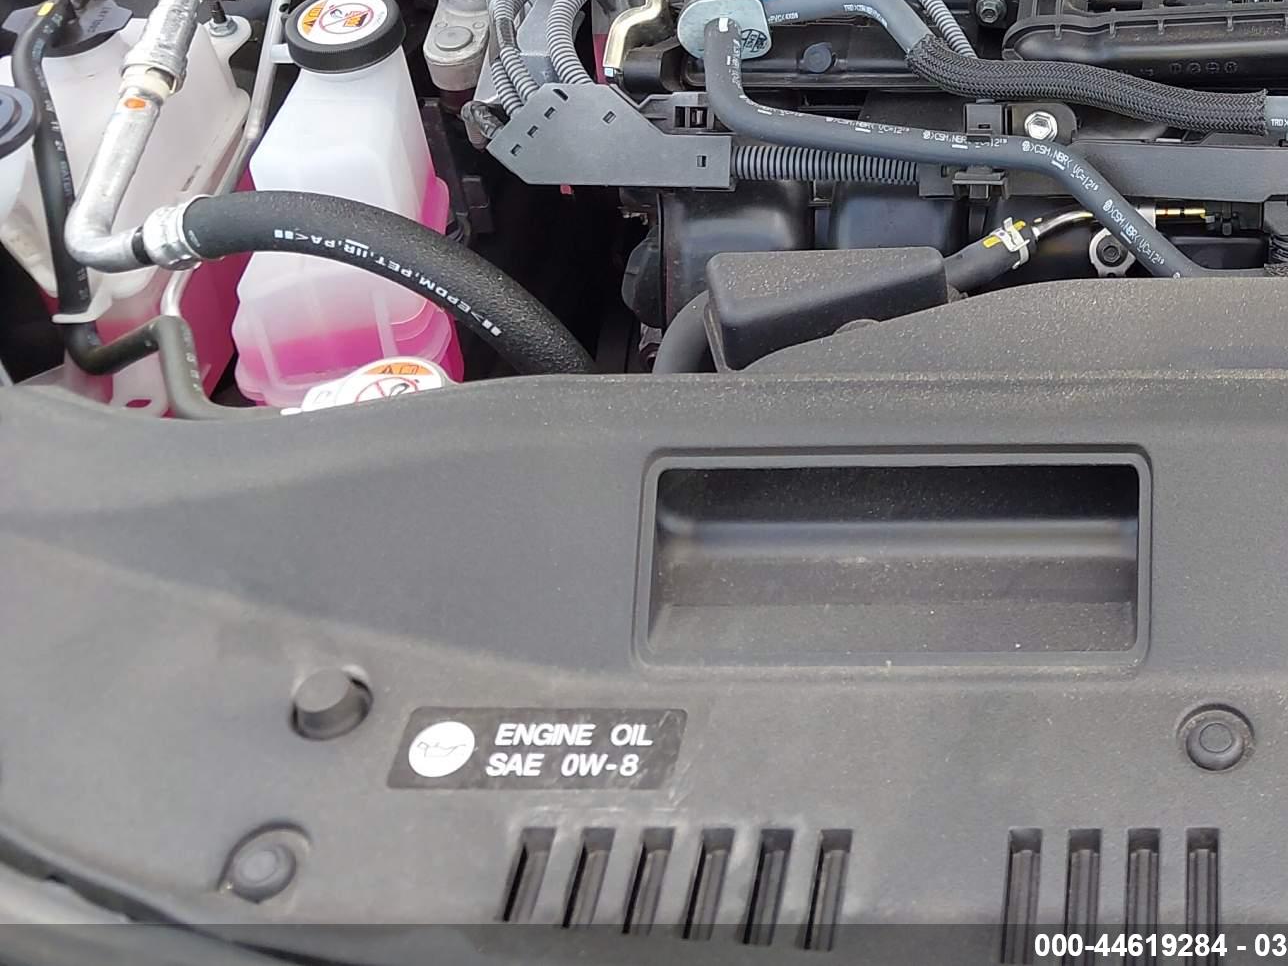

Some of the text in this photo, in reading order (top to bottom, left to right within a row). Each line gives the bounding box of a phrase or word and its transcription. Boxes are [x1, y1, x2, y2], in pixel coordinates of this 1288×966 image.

[495, 724, 653, 746] ENGINE OIL
[486, 753, 640, 777] SAE 0W-8
